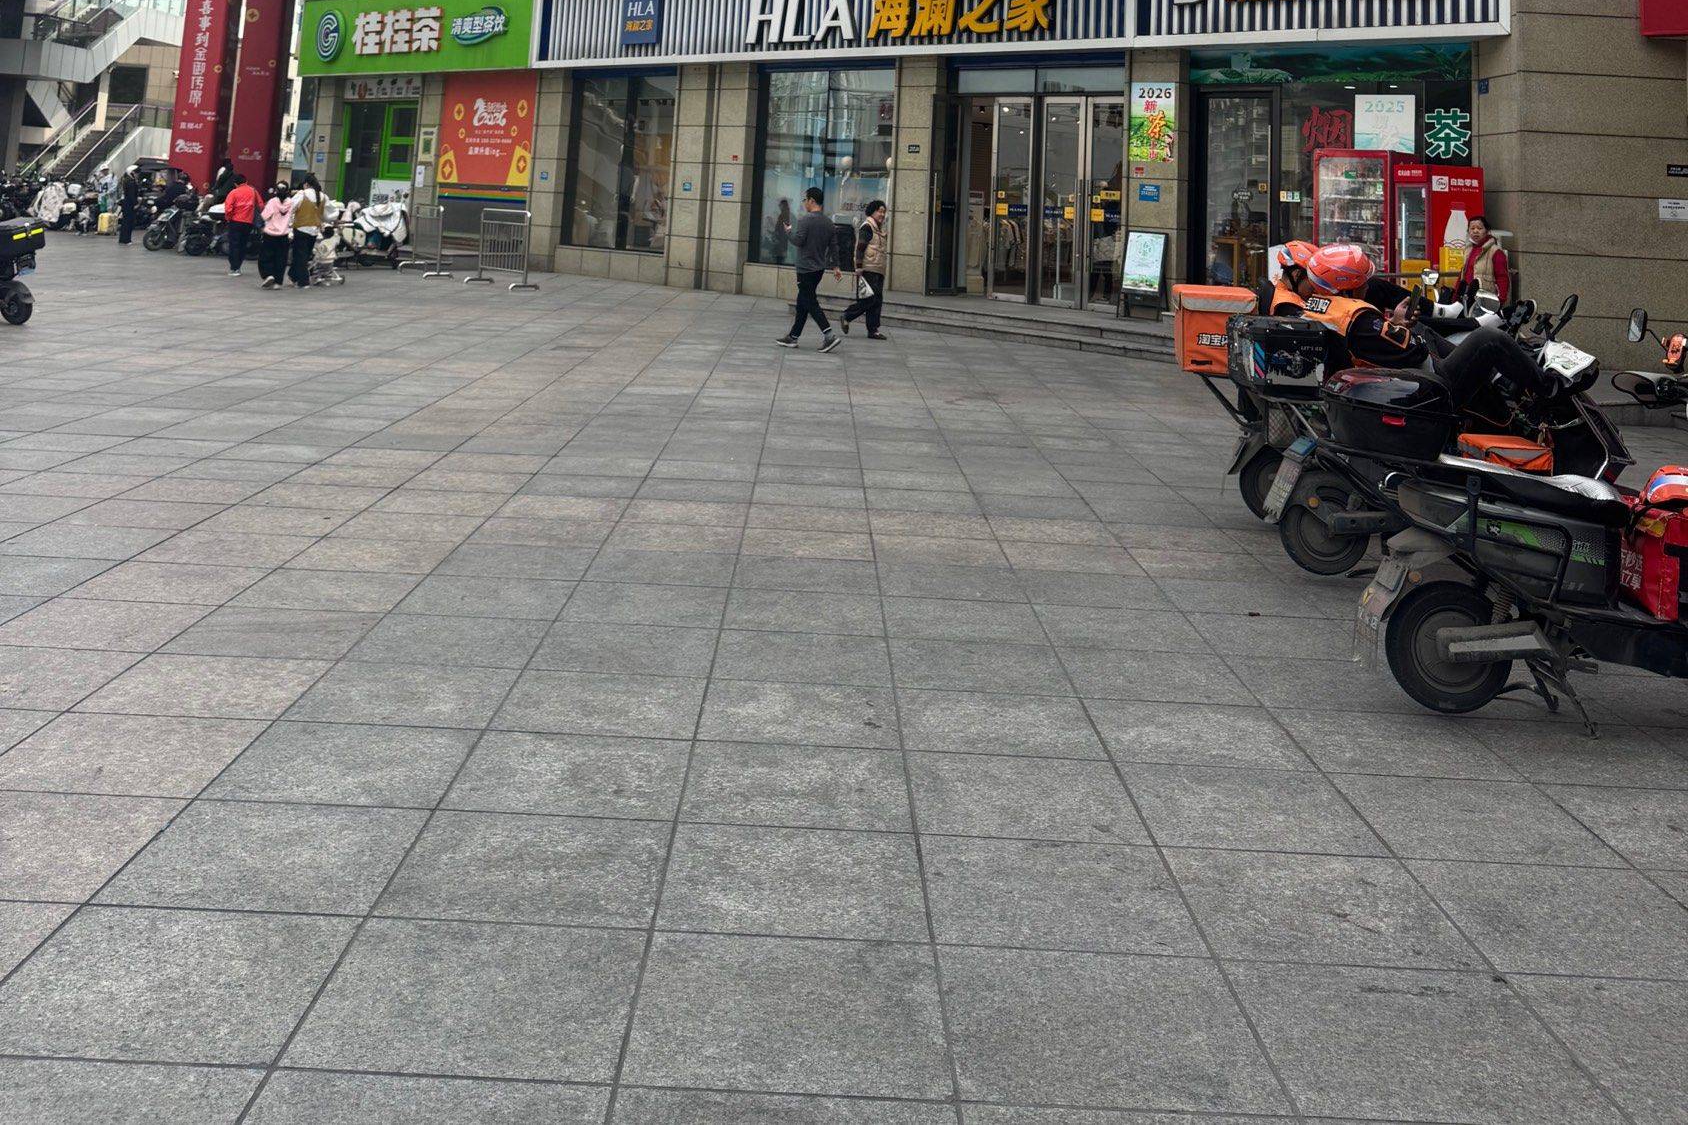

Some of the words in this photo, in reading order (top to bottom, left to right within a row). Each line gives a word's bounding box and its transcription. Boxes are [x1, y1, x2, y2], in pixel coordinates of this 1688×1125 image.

[627, 1, 655, 18] HLA
[352, 7, 443, 55] 桂桂茶
[451, 15, 506, 36] 清爽型茶饮
[1138, 87, 1172, 100] 2026
[1364, 101, 1405, 113] 2025
[1424, 108, 1472, 159] 茶
